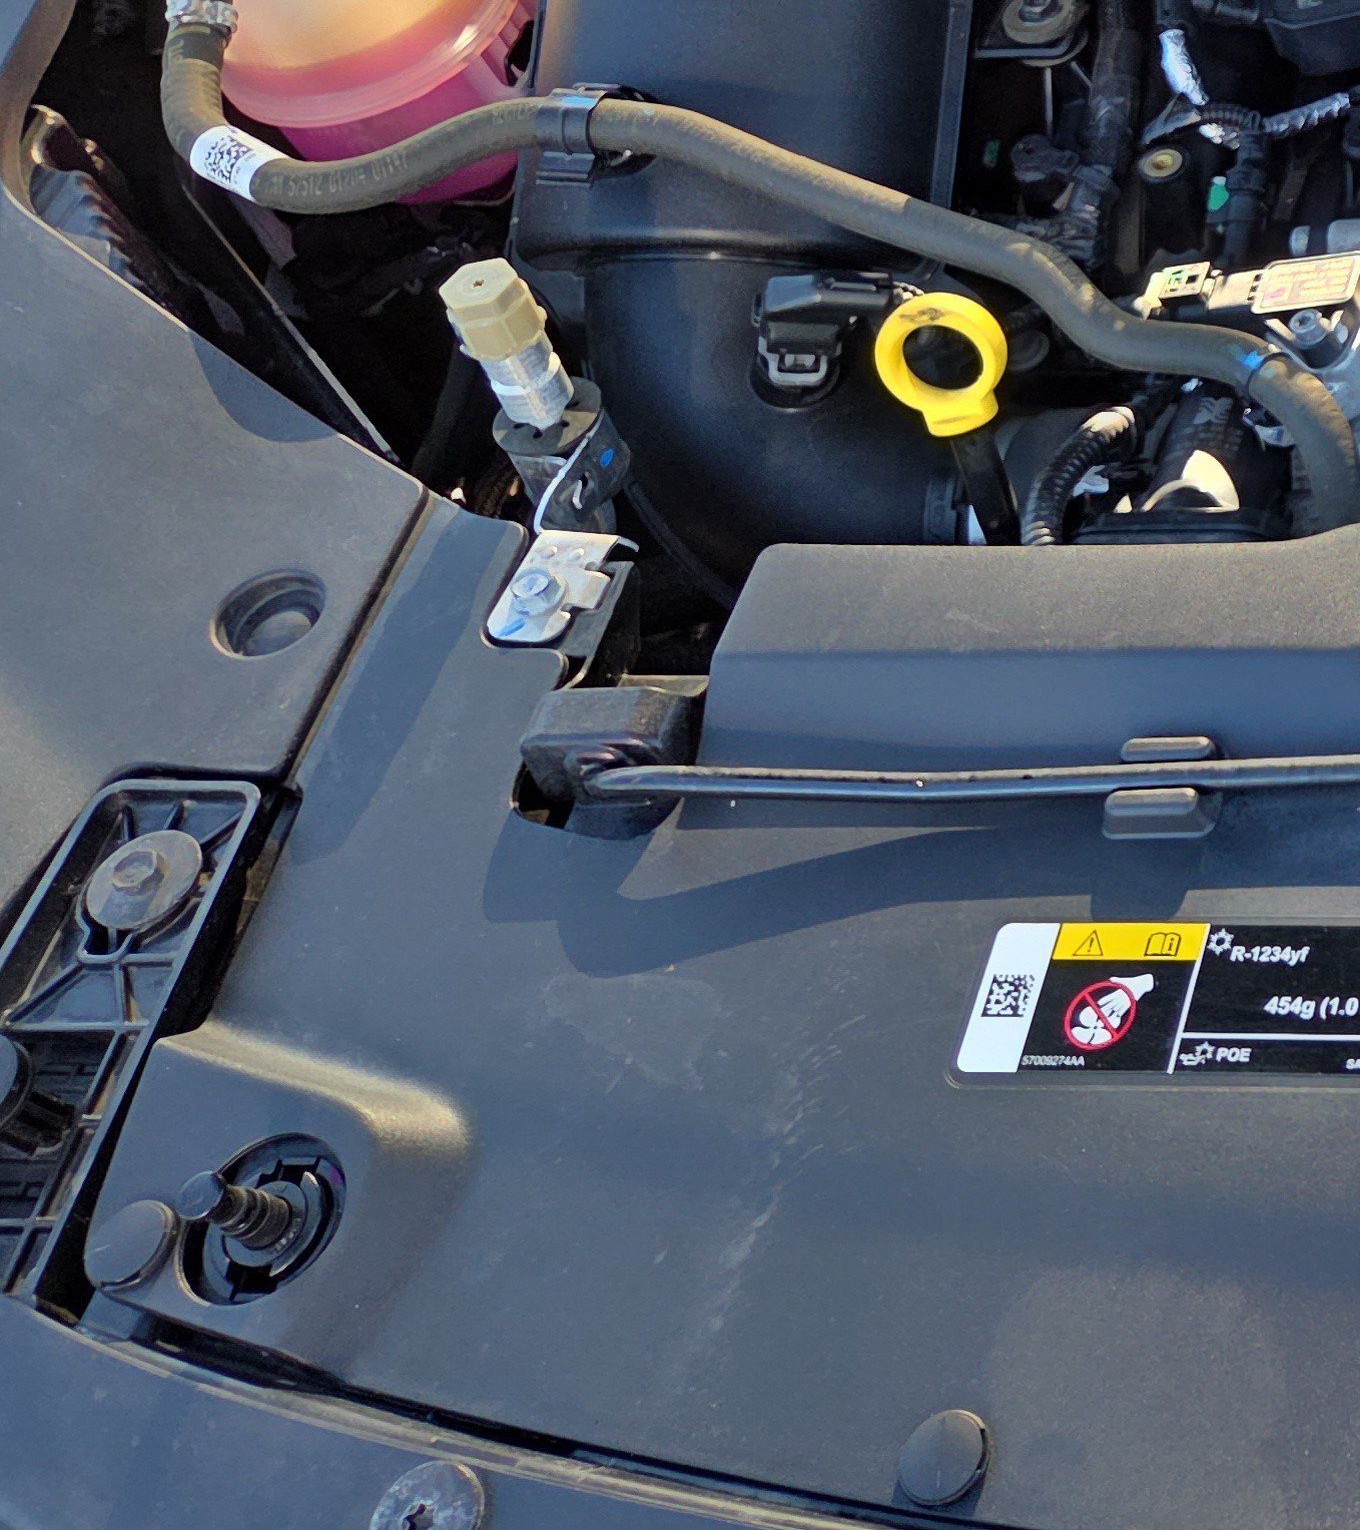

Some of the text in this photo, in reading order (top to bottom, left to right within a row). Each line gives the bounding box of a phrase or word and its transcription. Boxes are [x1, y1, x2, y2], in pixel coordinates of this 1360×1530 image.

[1230, 945, 1310, 966] R-1234yf
[1263, 995, 1315, 1020] 454g
[1319, 996, 1357, 1020] (1.0
[1215, 1047, 1252, 1063] POE
